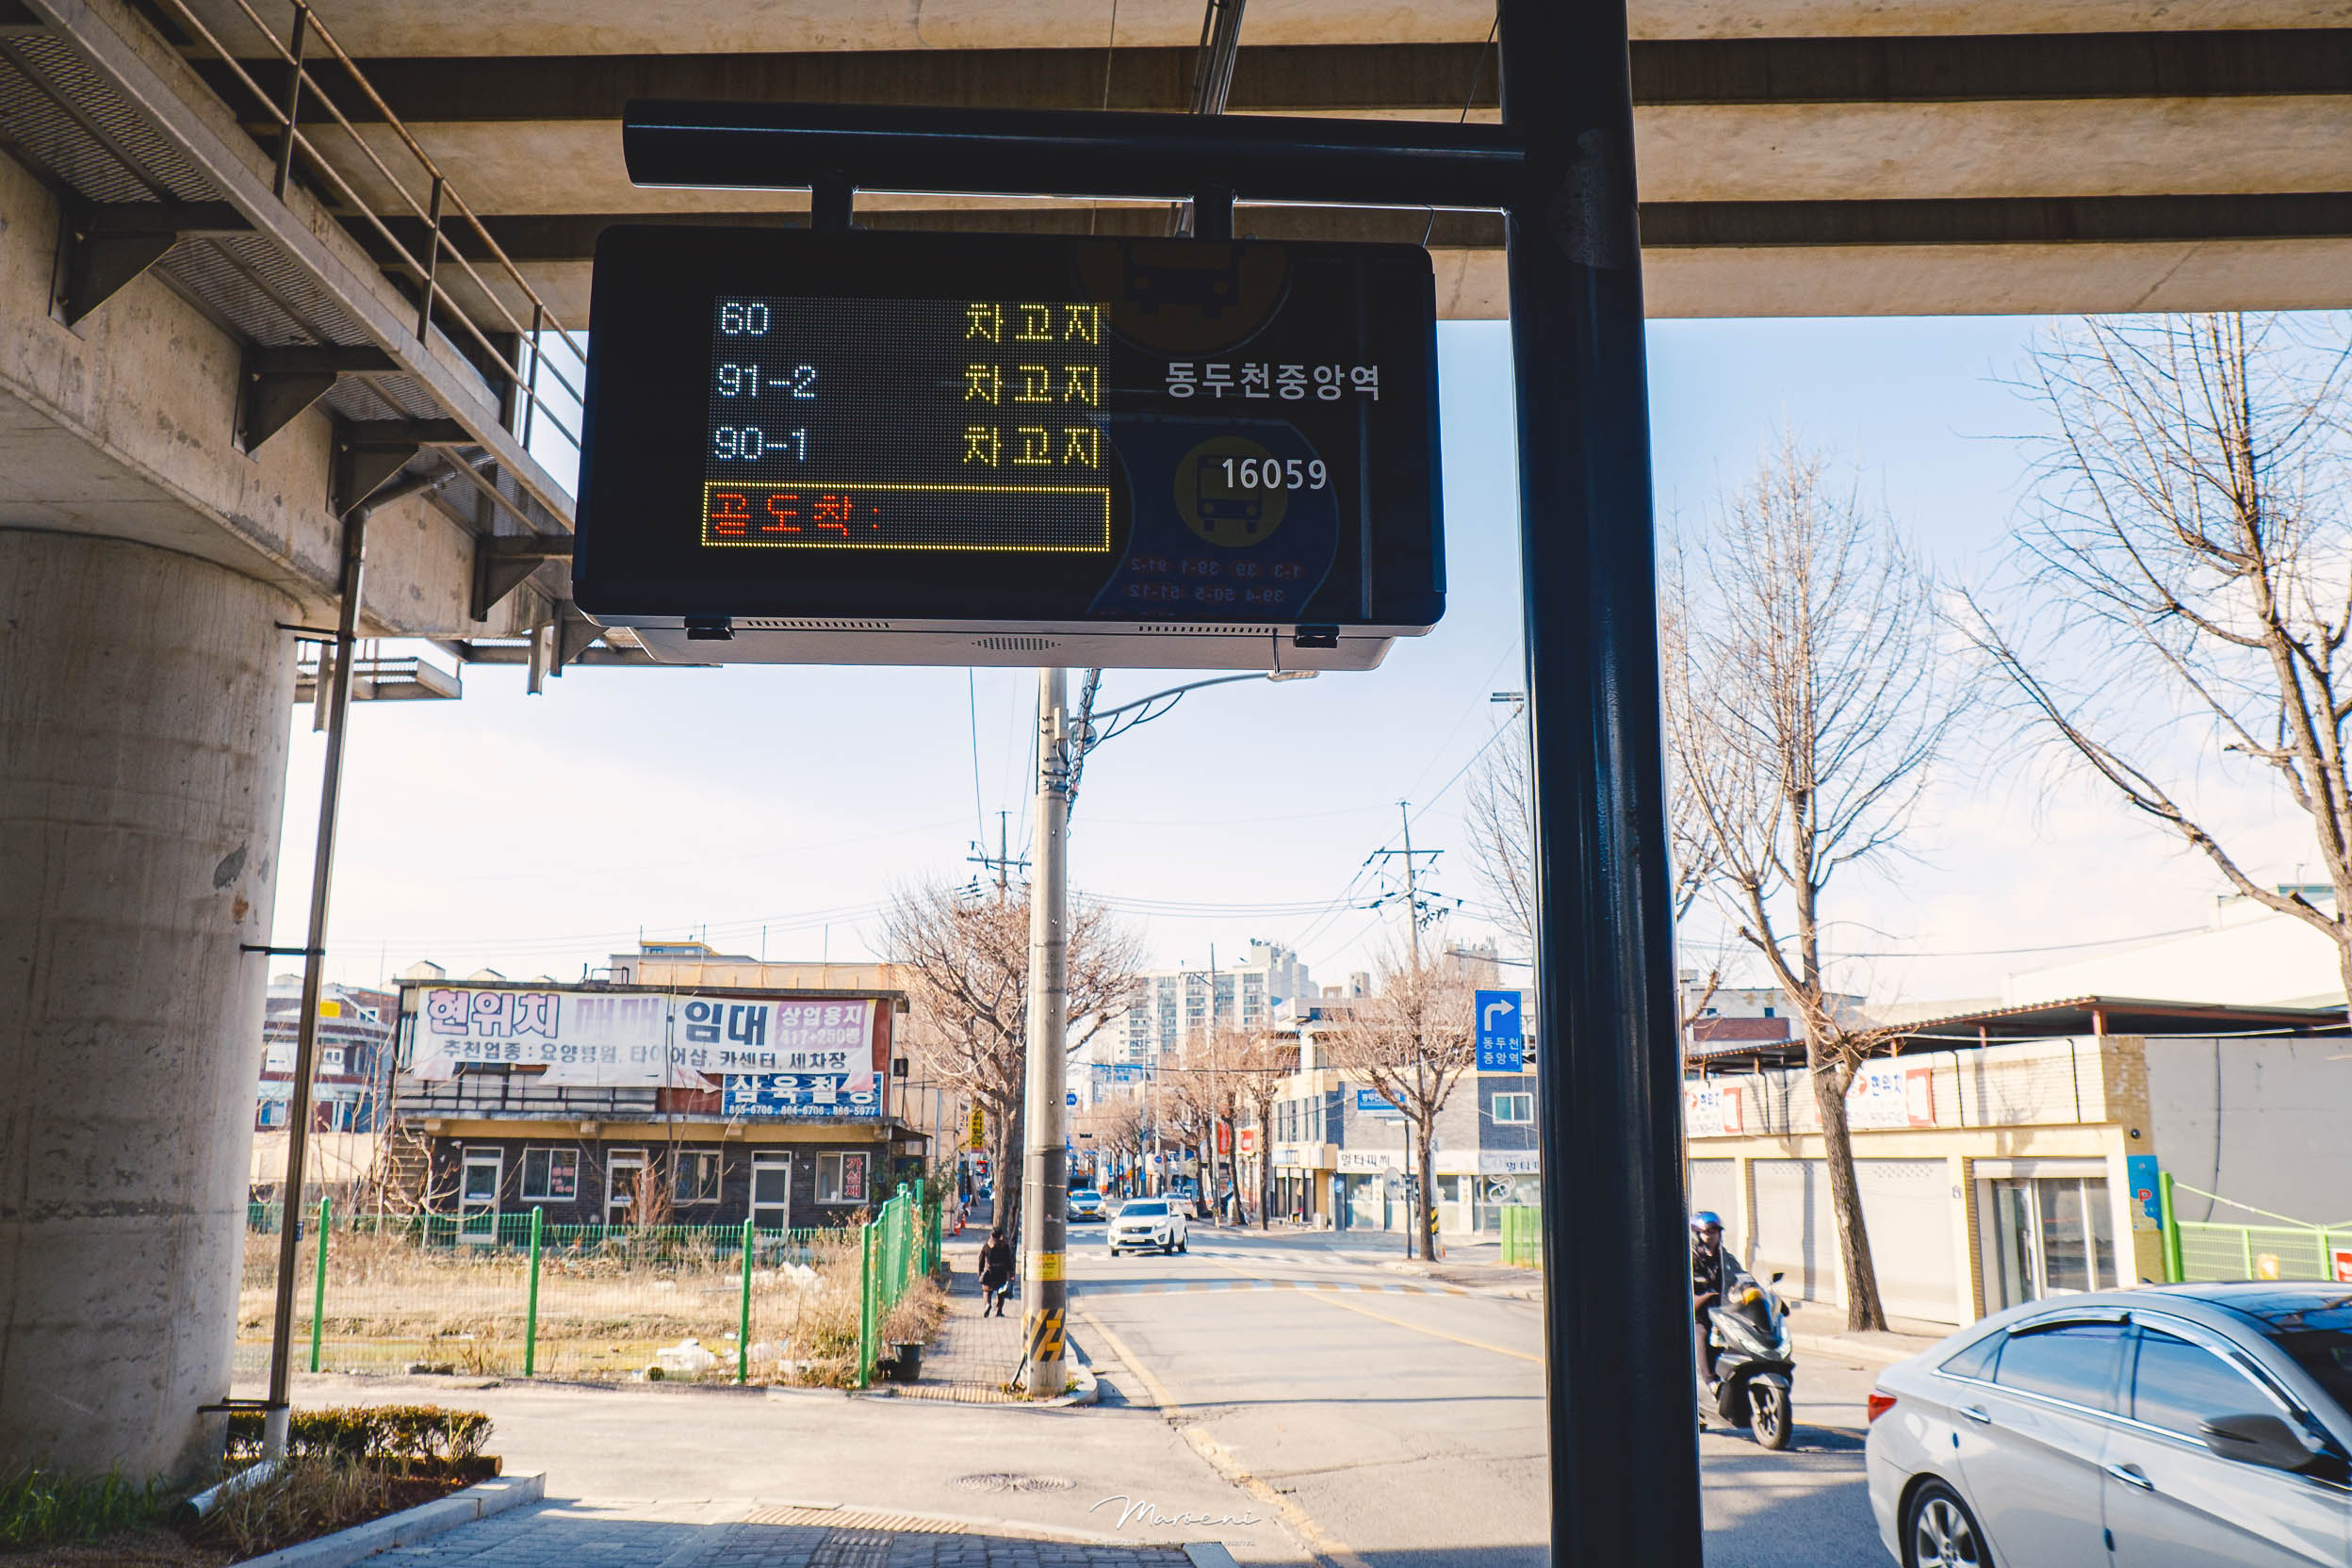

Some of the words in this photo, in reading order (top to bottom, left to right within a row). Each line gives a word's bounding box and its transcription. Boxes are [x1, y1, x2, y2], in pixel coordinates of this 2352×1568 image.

[721, 302, 769, 335] 60
[966, 302, 1099, 345] 차고지
[718, 364, 817, 399] 91-2
[965, 365, 1098, 406] 차고지
[1165, 362, 1380, 401] 동두천중앙역
[714, 427, 807, 461] 90-1
[964, 426, 1098, 469] 차고지
[1221, 458, 1327, 489] 16059
[427, 988, 560, 1038] 현위치
[684, 1001, 768, 1046] 임대
[781, 1004, 864, 1026] 상업용지
[790, 1052, 846, 1070] 세차장
[1483, 1037, 1519, 1051] 동두천
[1483, 1052, 1519, 1066] 중앙역
[844, 1157, 863, 1198] 가설재
